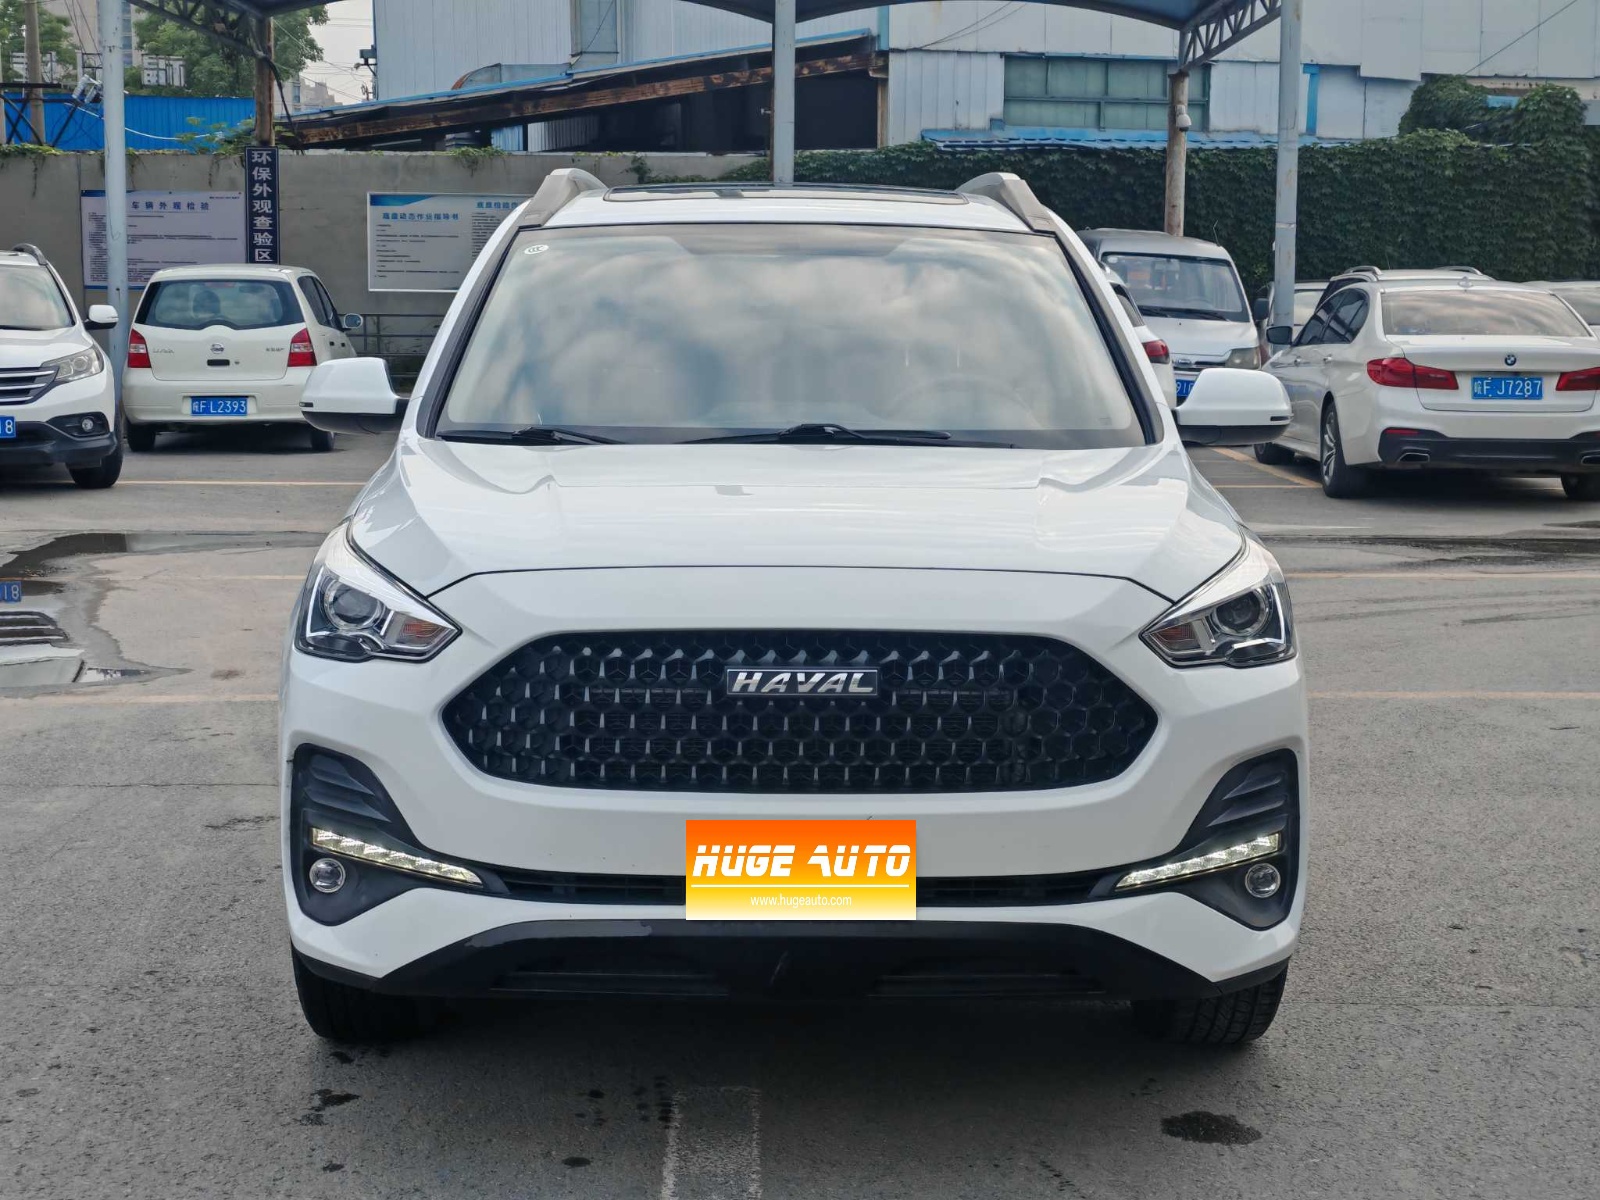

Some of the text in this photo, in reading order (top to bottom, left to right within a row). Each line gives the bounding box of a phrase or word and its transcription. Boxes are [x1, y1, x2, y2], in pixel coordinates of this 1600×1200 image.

[251, 150, 274, 262] 环保外观查验区
[732, 671, 875, 693] HAVAL
